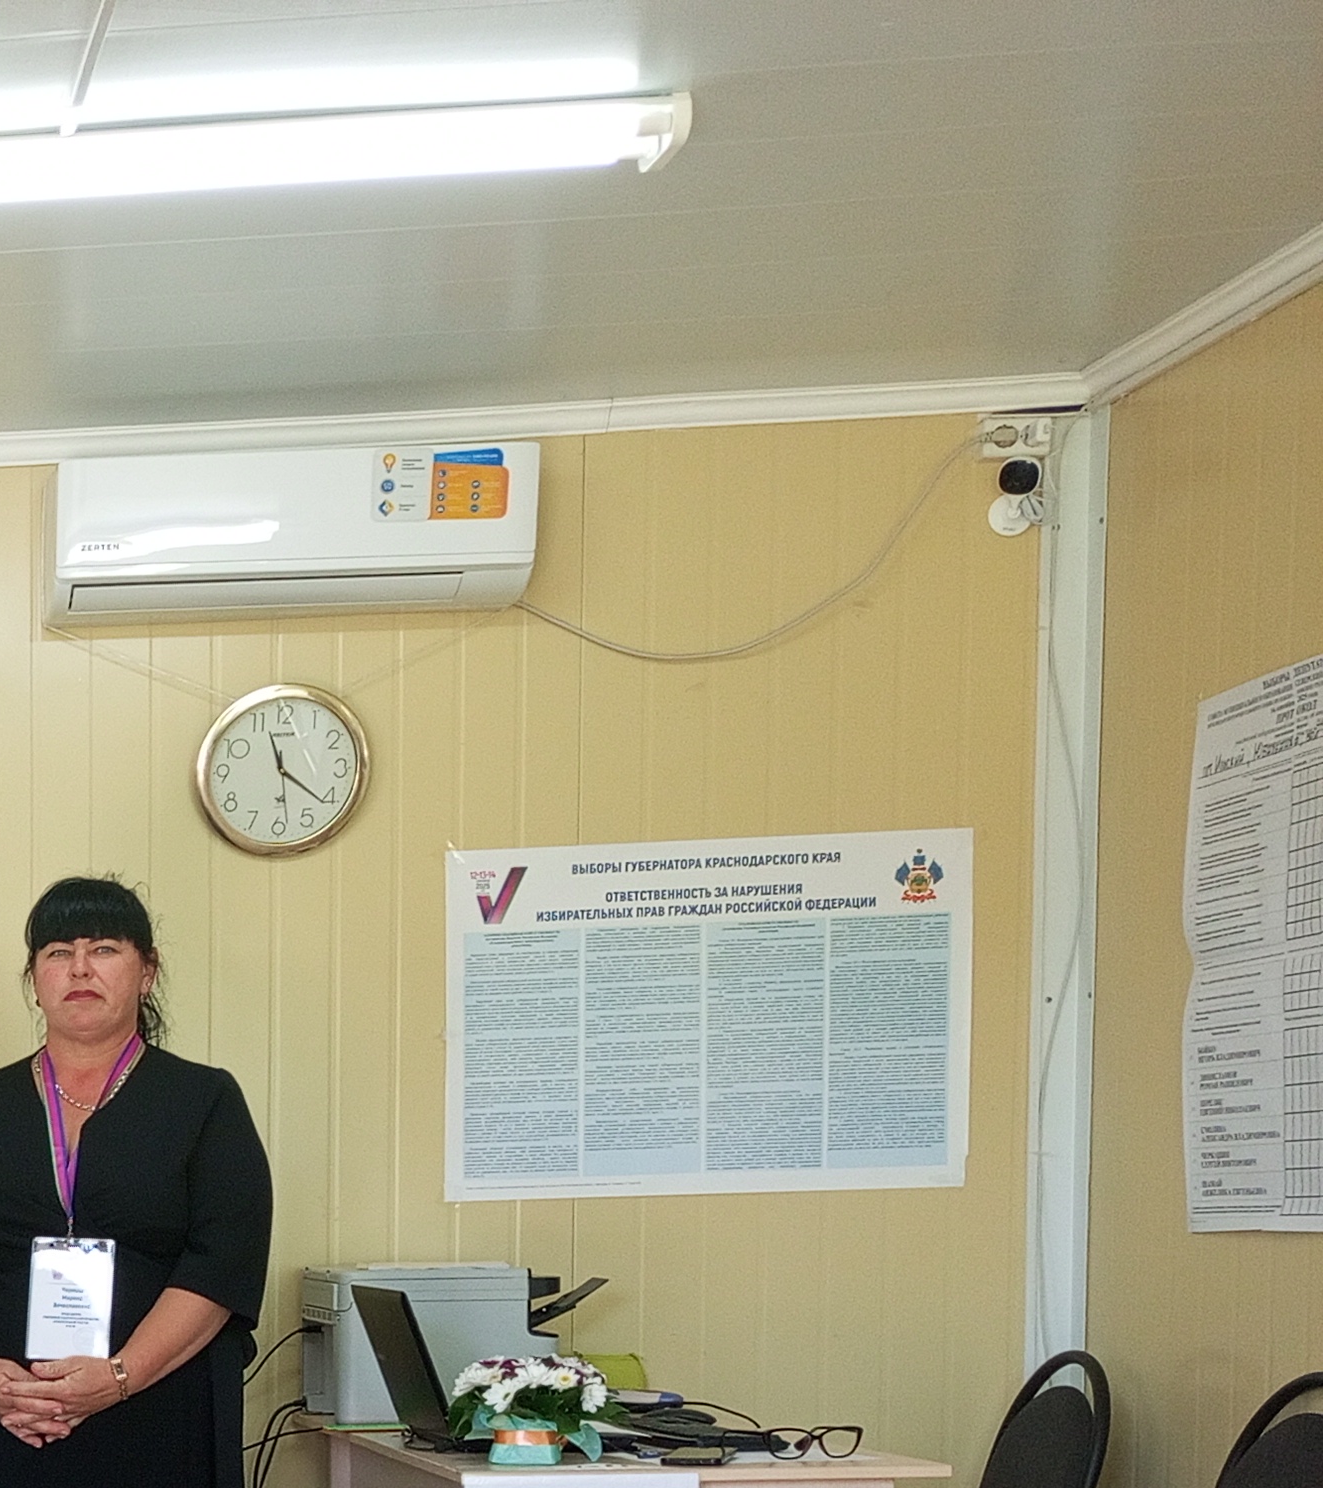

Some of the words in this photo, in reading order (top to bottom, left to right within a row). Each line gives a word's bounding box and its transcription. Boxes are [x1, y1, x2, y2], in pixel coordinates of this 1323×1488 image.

[250, 712, 265, 733] 11
[277, 704, 294, 725] 12
[223, 738, 251, 760] 10
[326, 729, 341, 750] 2
[216, 763, 231, 784] 9
[333, 758, 349, 779] 3
[223, 791, 238, 812] 8
[321, 786, 336, 805] 4
[247, 810, 259, 831] 7
[270, 816, 287, 836] 6
[299, 808, 315, 829] 5
[572, 862, 622, 875] ВЫБОРЫ
[625, 858, 702, 873] ГУБЕРНАТОРА
[705, 853, 809, 869] КРАСНОДАРСКОГО
[812, 852, 841, 863] КРАЯ
[605, 888, 711, 903] ОТВЕТСТВЕННОСТЬ
[714, 887, 728, 898] ЗА
[731, 883, 803, 897] НАРУШЕНИЯ
[536, 907, 633, 922] ИЗБИРАТЕЛЬНЫХ
[636, 906, 665, 918] ПРАВ
[668, 903, 722, 916] ГРАЖДАН
[725, 898, 802, 914] РОССИЙСКОЙ
[805, 897, 877, 911] ФЕДЕРАЦИИ
